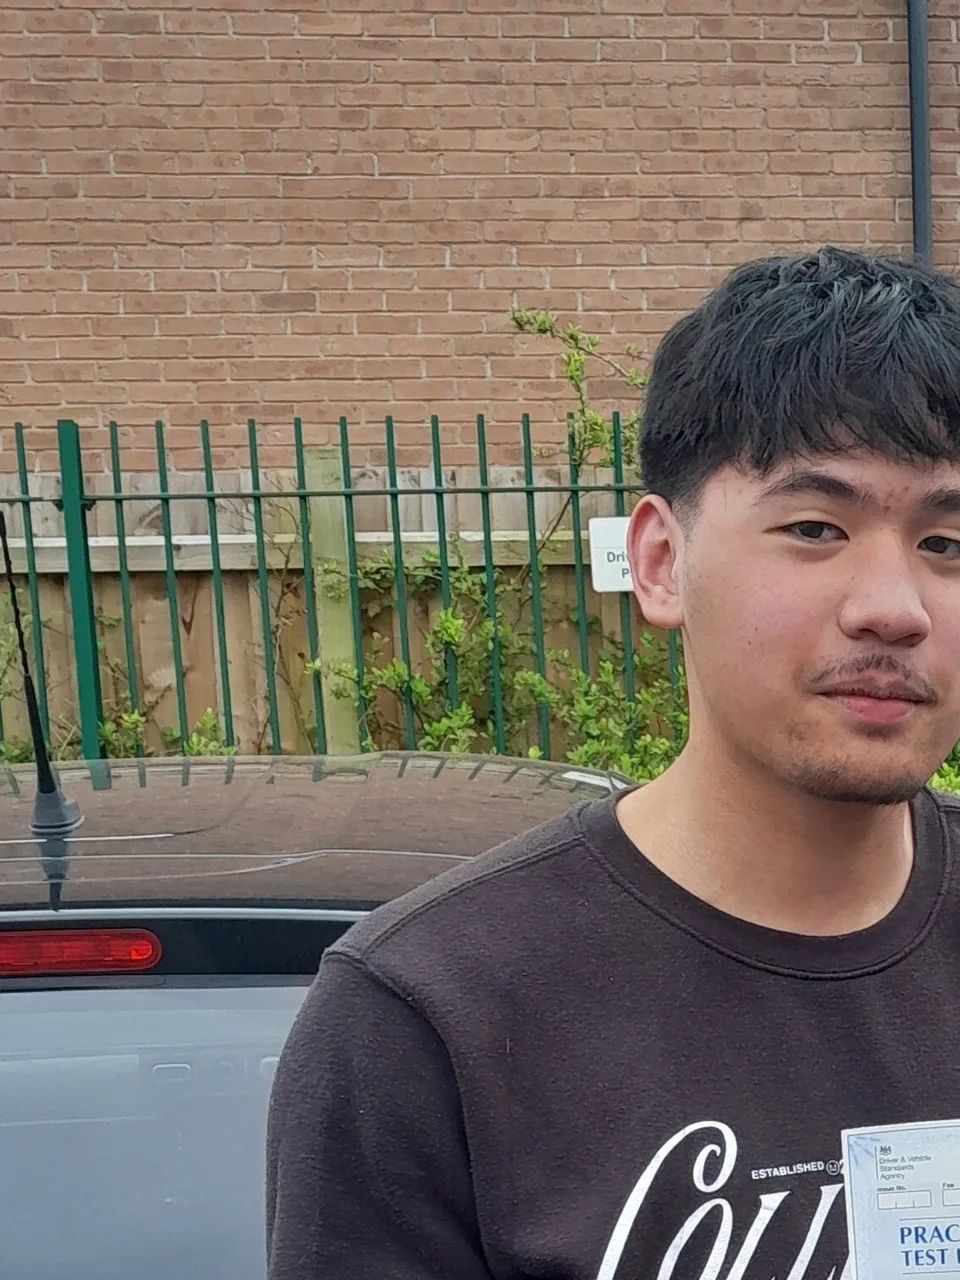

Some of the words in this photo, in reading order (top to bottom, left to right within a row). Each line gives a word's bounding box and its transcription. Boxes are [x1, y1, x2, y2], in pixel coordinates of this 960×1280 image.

[606, 552, 628, 562] Dri
[751, 1161, 824, 1179] ESTABLISHED
[900, 1248, 948, 1266] TEST
